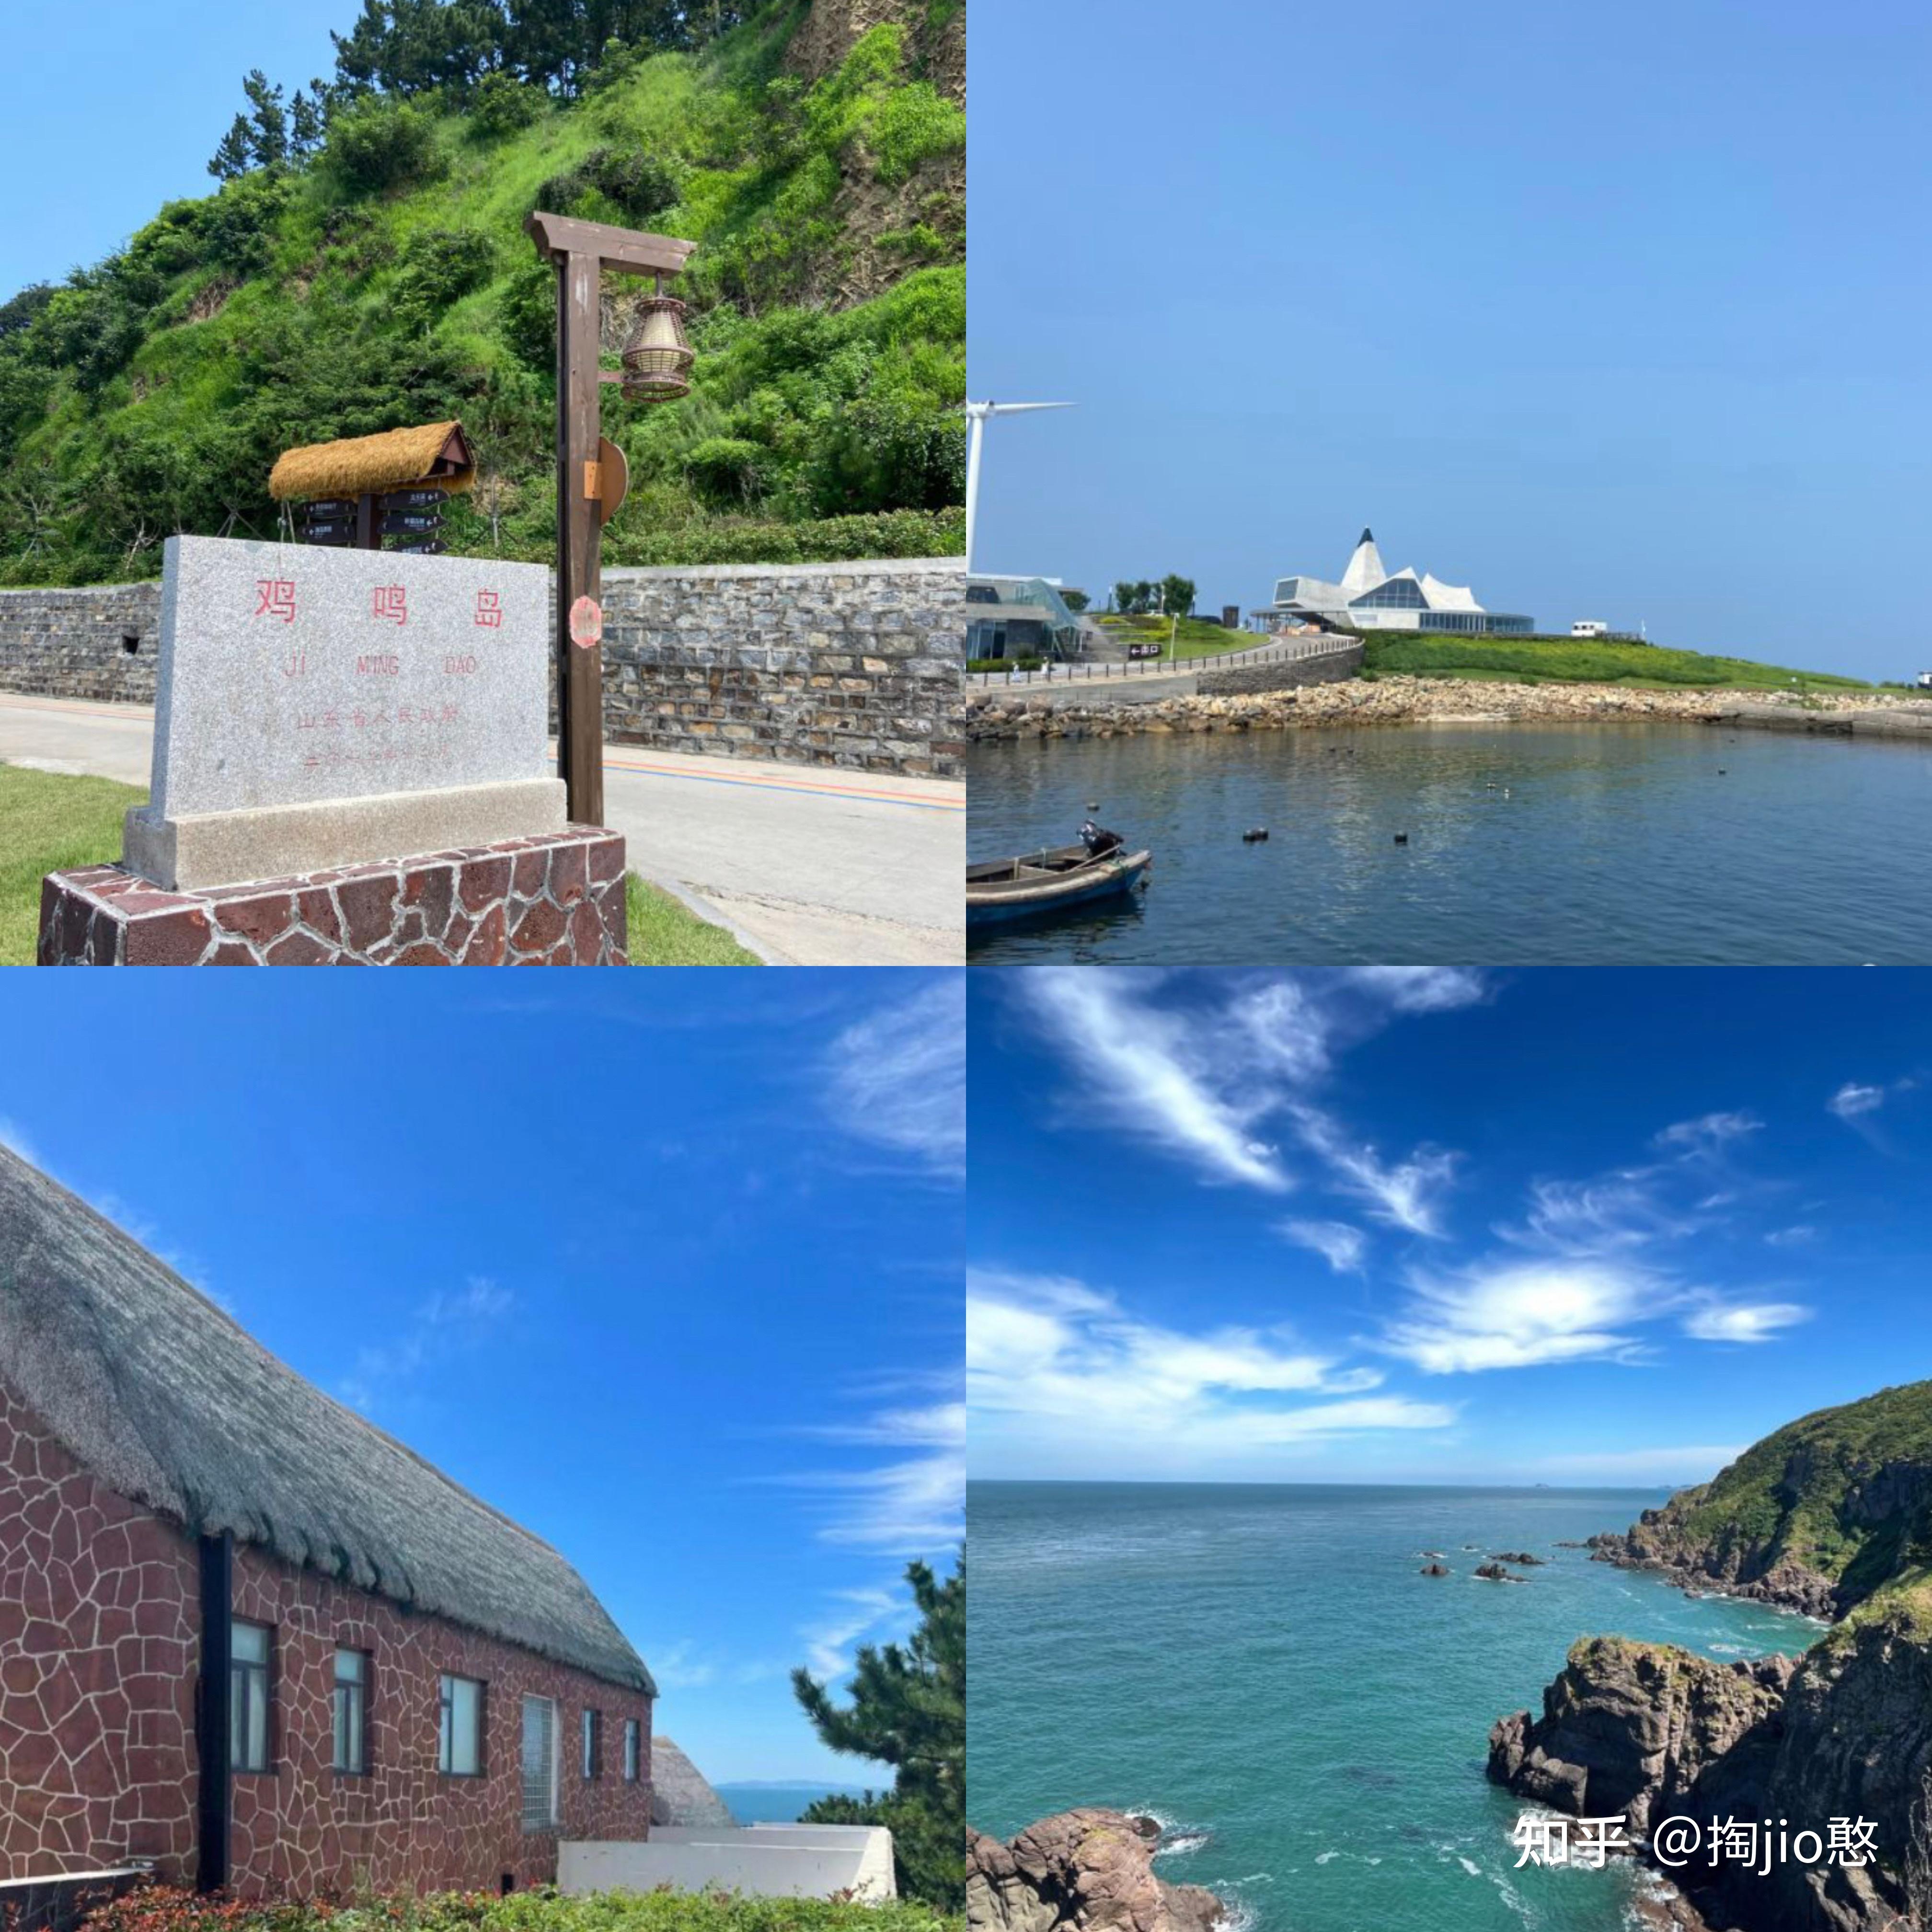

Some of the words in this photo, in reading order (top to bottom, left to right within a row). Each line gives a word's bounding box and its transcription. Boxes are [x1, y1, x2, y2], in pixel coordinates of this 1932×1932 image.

[255, 577, 502, 627] 鸡鸣岛
[285, 655, 305, 677] JI
[356, 656, 399, 675] MING
[444, 656, 476, 674] DAO
